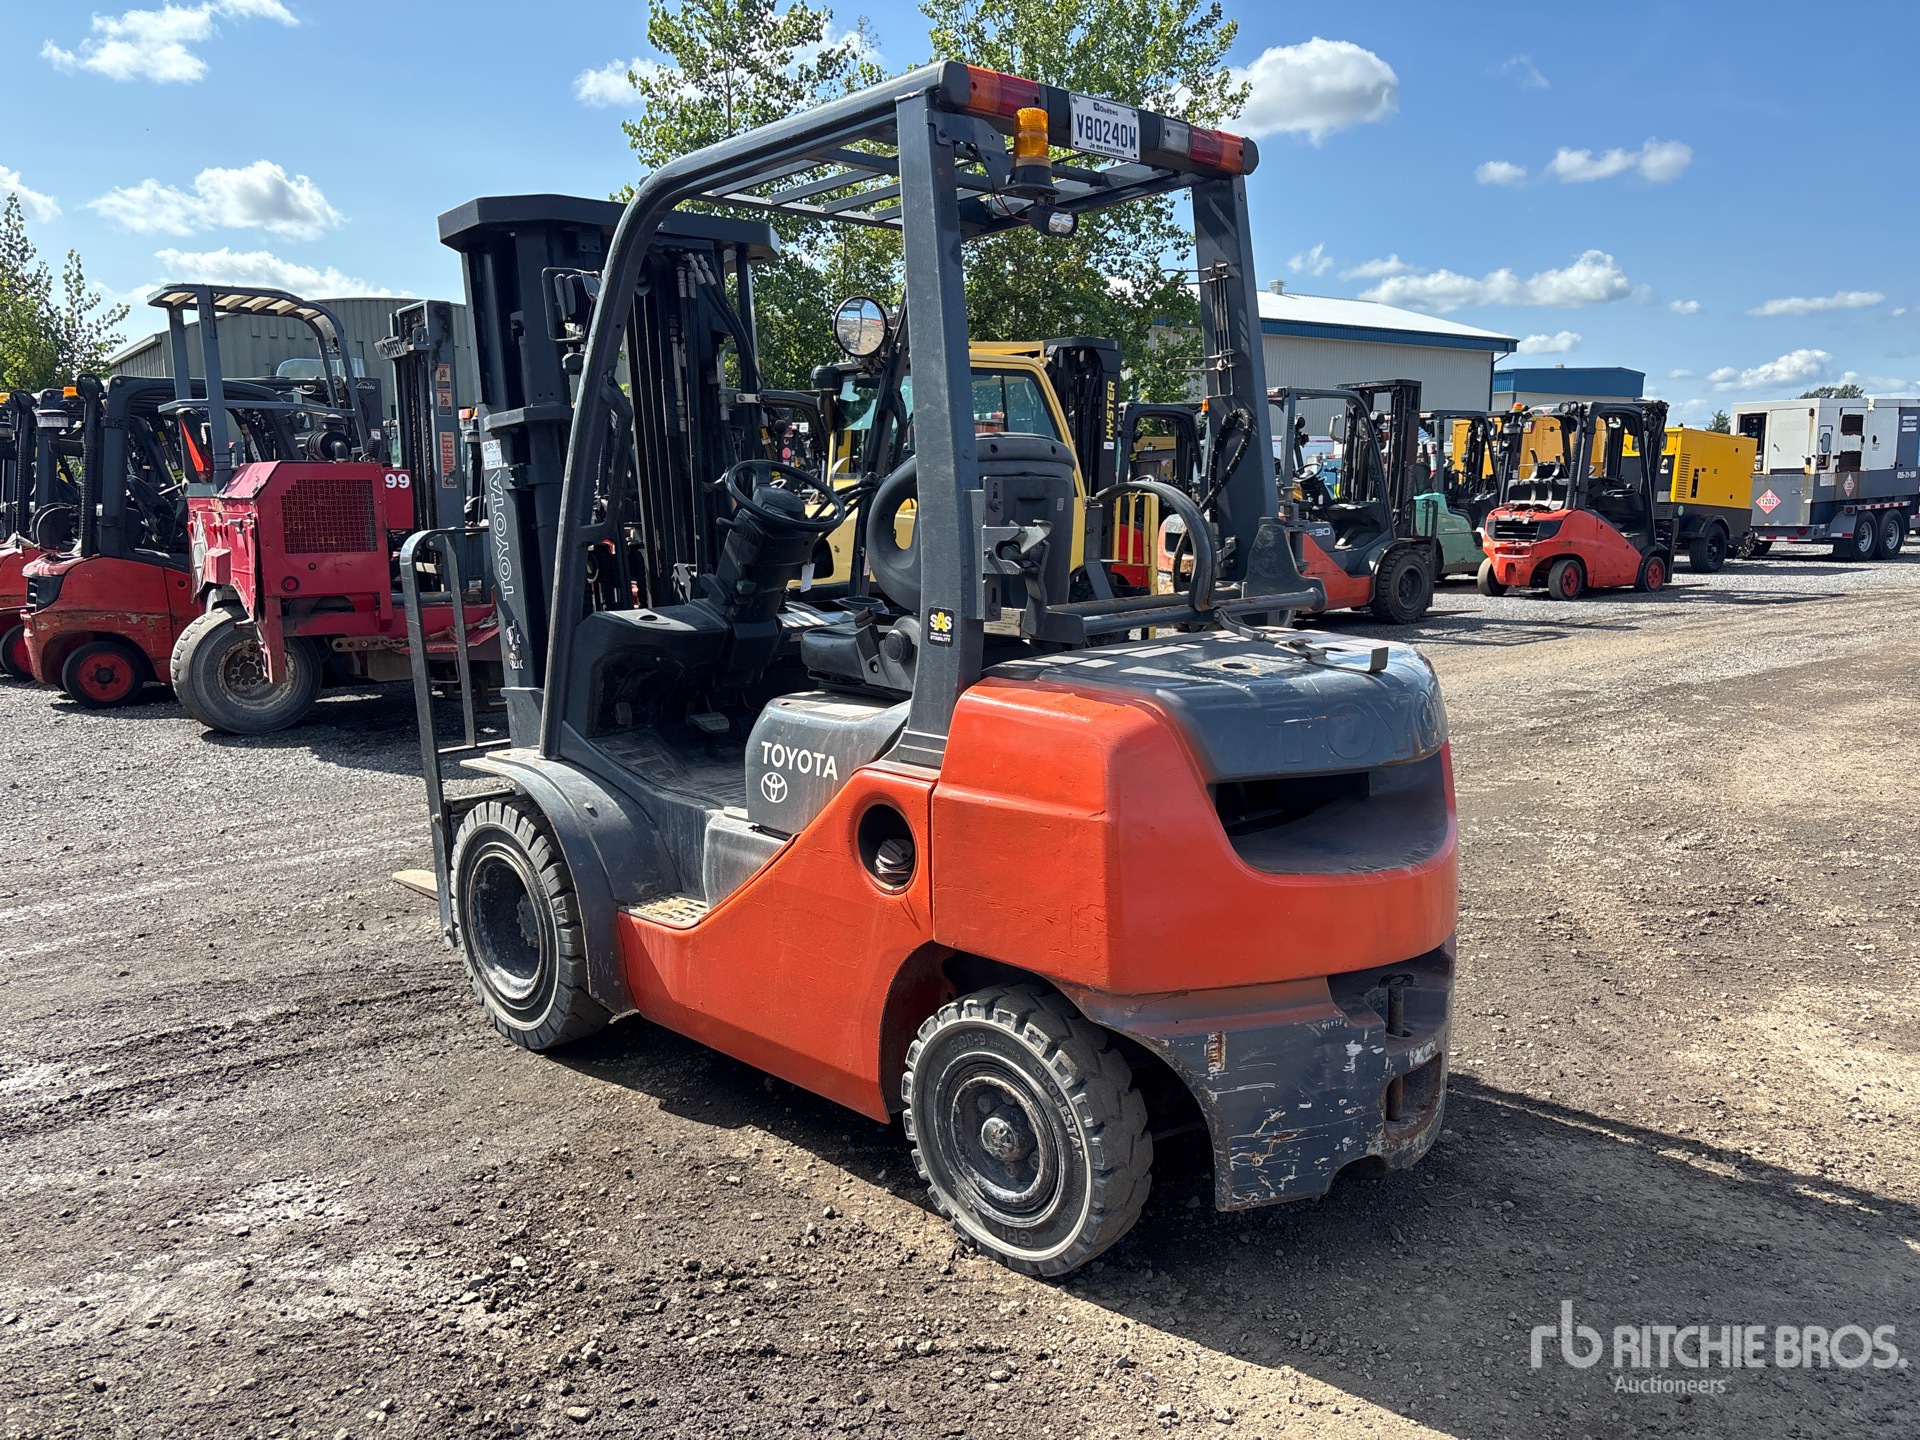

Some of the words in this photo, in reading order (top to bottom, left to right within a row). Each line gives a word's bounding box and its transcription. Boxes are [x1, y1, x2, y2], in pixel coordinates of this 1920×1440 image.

[355, 381, 376, 390] Linde
[1105, 381, 1115, 440] HYSTER
[441, 433, 455, 474] MOFFETT
[384, 473, 410, 488] 99
[489, 469, 515, 601] TOYOTA
[930, 611, 952, 632] SAS
[761, 740, 839, 781] TOYOTA
[949, 1032, 987, 1054] 6.00-9
[1033, 1063, 1084, 1161] GLOBESTAR
